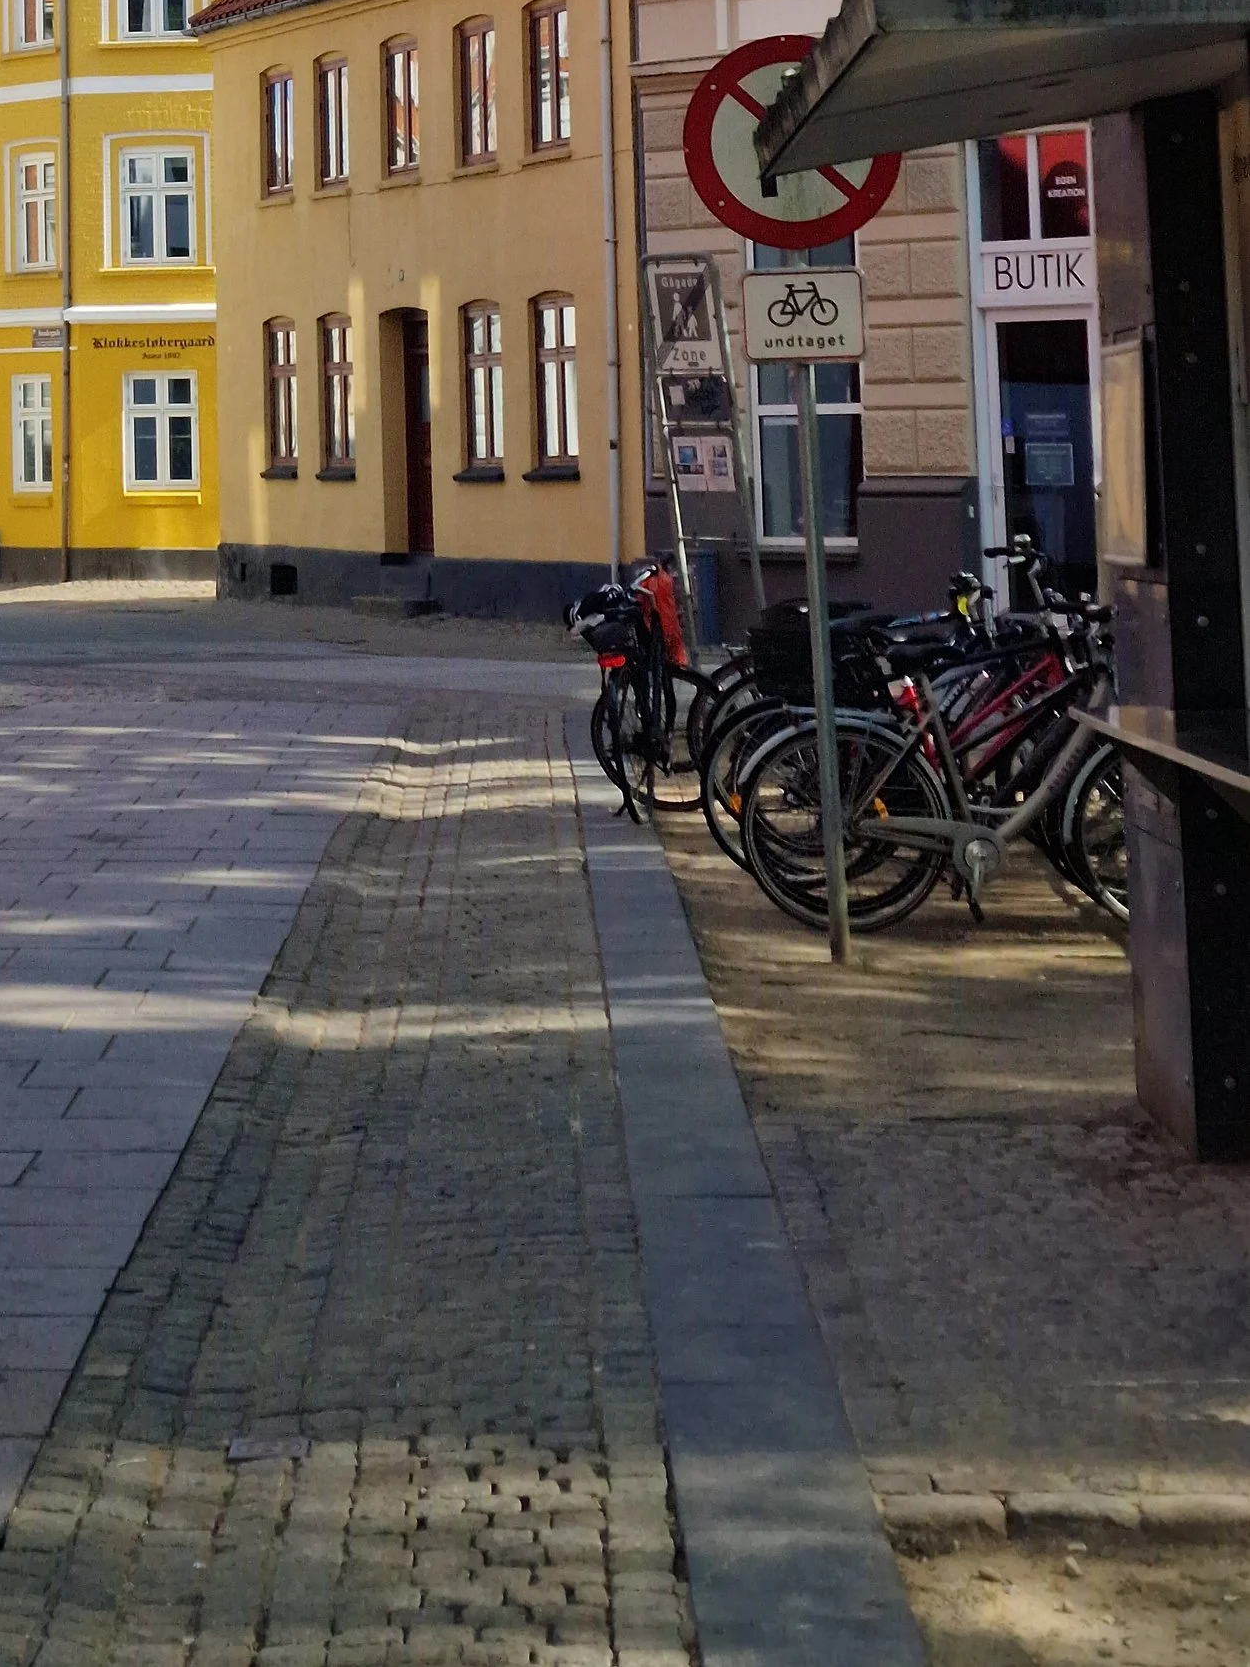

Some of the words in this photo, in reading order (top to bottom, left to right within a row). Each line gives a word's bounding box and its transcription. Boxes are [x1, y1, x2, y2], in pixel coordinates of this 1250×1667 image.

[995, 253, 1085, 290] BUTIK
[765, 334, 846, 349] undtaget
[672, 347, 707, 361] Zone
